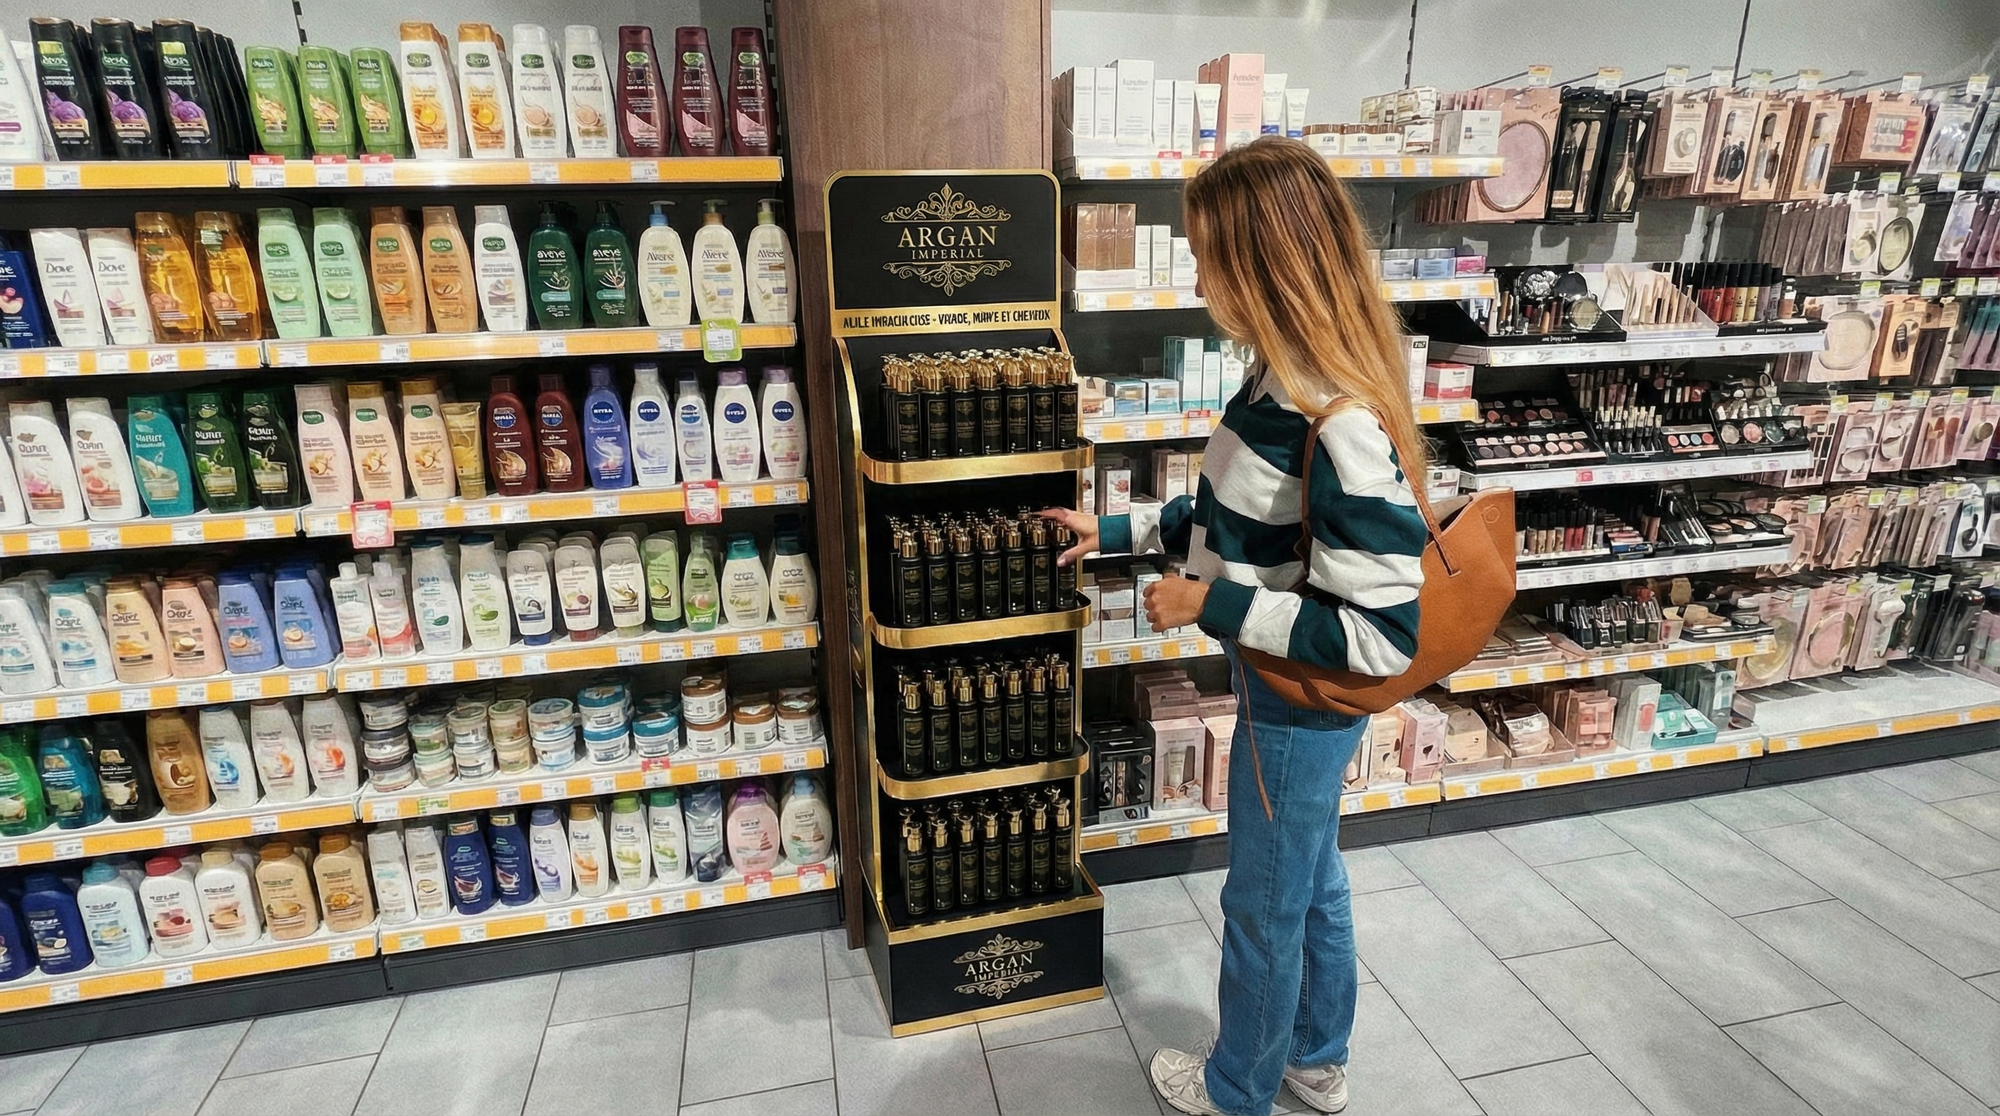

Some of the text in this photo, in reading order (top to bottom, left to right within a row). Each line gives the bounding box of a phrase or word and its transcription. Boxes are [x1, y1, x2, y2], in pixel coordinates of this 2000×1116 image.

[897, 225, 998, 248] ARGAN
[912, 248, 984, 260] IMPERIAL
[964, 951, 1034, 976] ARGAN
